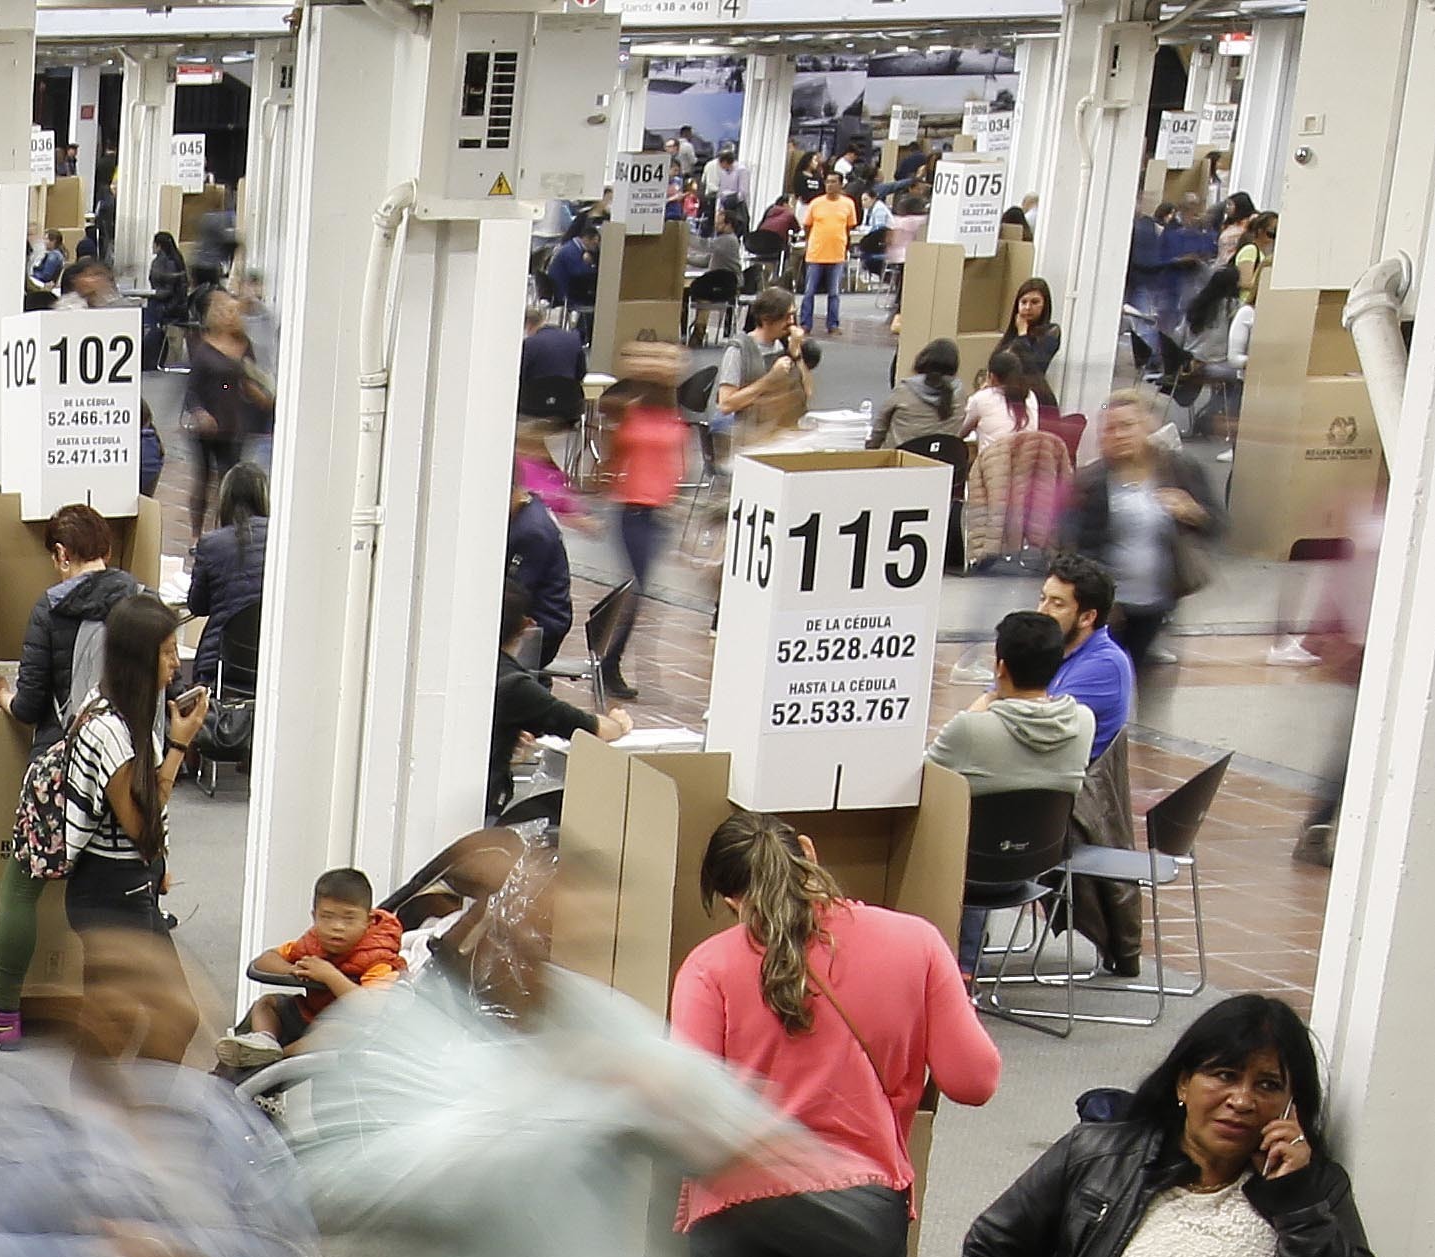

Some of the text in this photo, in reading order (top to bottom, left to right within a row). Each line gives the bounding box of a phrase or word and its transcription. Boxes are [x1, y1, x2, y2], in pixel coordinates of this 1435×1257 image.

[690, 1, 710, 11] 401
[722, 0, 740, 19] 4
[989, 119, 1010, 132] 034
[1172, 120, 1198, 133] 047
[31, 138, 52, 151] 036
[179, 141, 203, 155] 045
[630, 163, 664, 183] 064
[934, 172, 959, 196] 075
[965, 173, 1003, 196] 075
[2, 337, 36, 389] 102
[49, 335, 135, 385] 102
[64, 399, 73, 407] DE
[75, 399, 85, 407] LA
[48, 410, 130, 426] 52.466.120
[56, 437, 79, 446] HASTA
[82, 437, 91, 445] LA
[47, 448, 129, 465] 52.471.311
[732, 498, 775, 590] 115
[789, 508, 930, 592] 115
[806, 615, 892, 632] DE LA CÉDULA
[777, 634, 917, 664] 52.528.402
[789, 677, 897, 695] HASTA LA CÉDULA
[771, 697, 911, 726] 52.533.767
